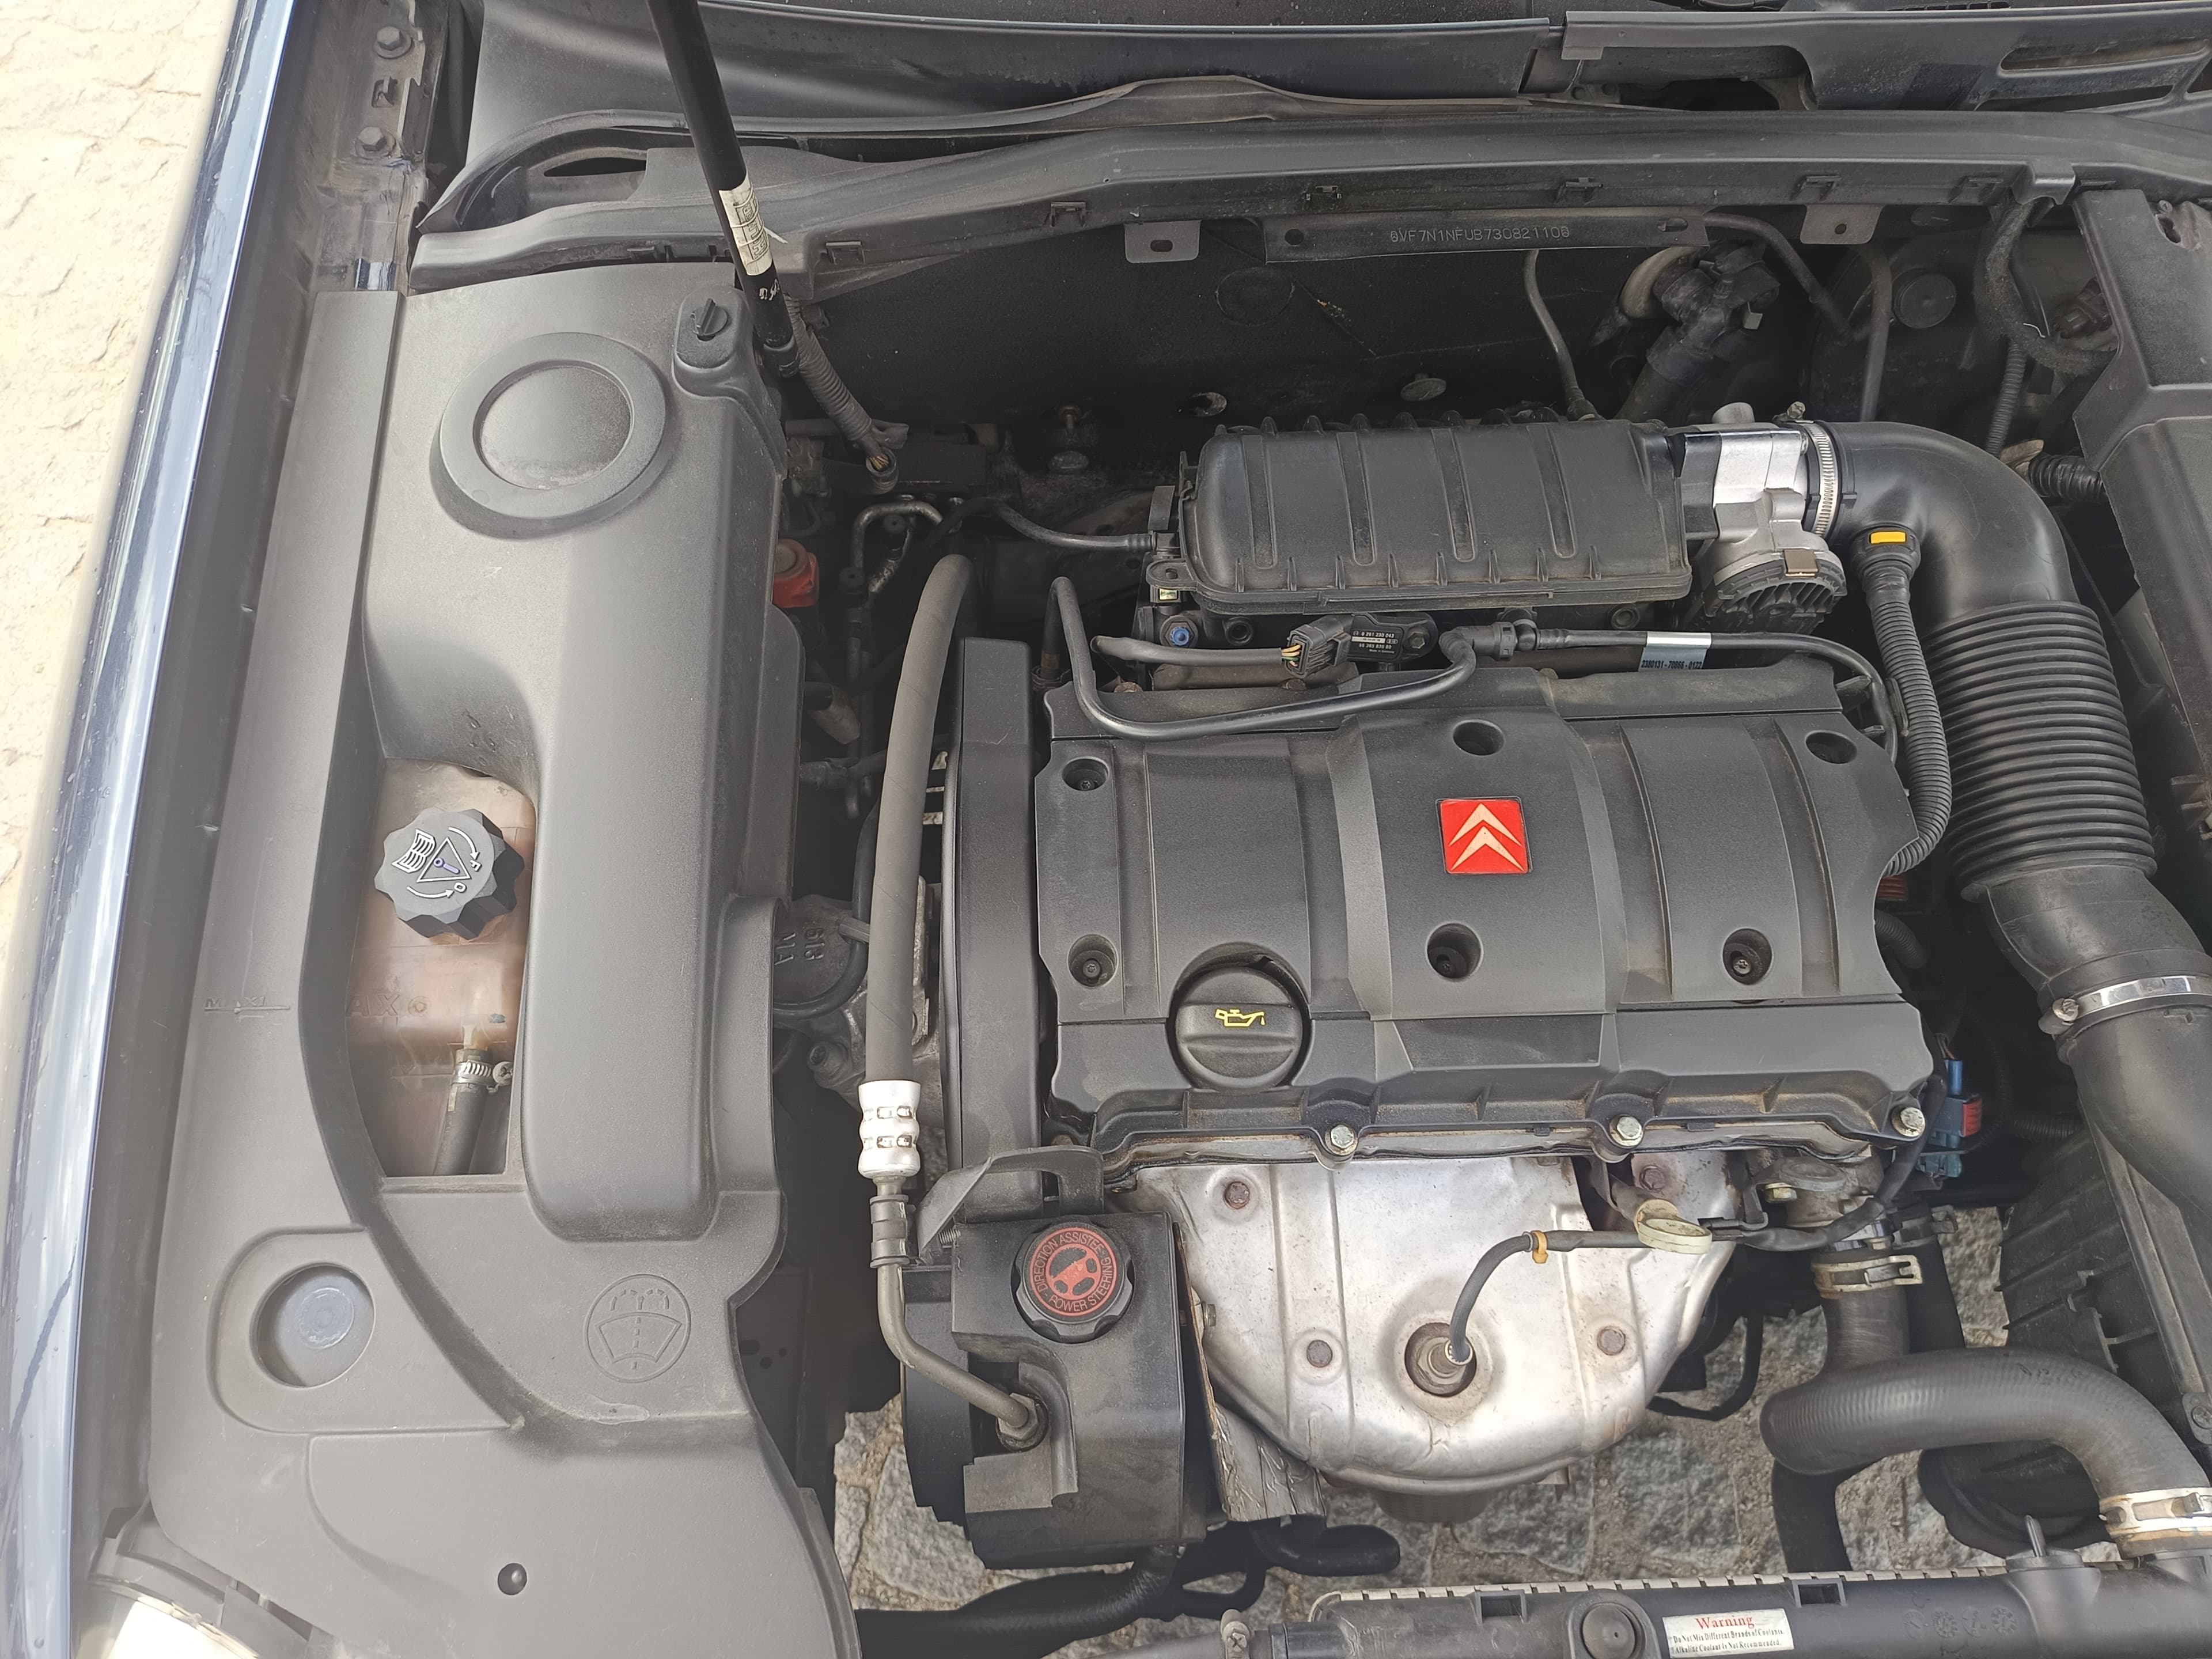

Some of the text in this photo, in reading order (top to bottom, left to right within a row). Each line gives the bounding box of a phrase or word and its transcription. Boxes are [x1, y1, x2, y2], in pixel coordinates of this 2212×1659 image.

[470, 860, 482, 872] F
[1034, 1232, 1104, 1293] DIRECTION ASSISTEE
[1048, 1256, 1113, 1312] POWER STEERING
[1695, 1615, 1755, 1630] Warning
[1681, 1634, 1692, 1642] Not
[1693, 1633, 1704, 1641] Mix
[1705, 1631, 1730, 1640] Different
[1731, 1630, 1751, 1639] Brands
[1751, 1629, 1758, 1637] of
[1699, 1643, 1721, 1653] Coolant
[1728, 1642, 1738, 1650] Not
